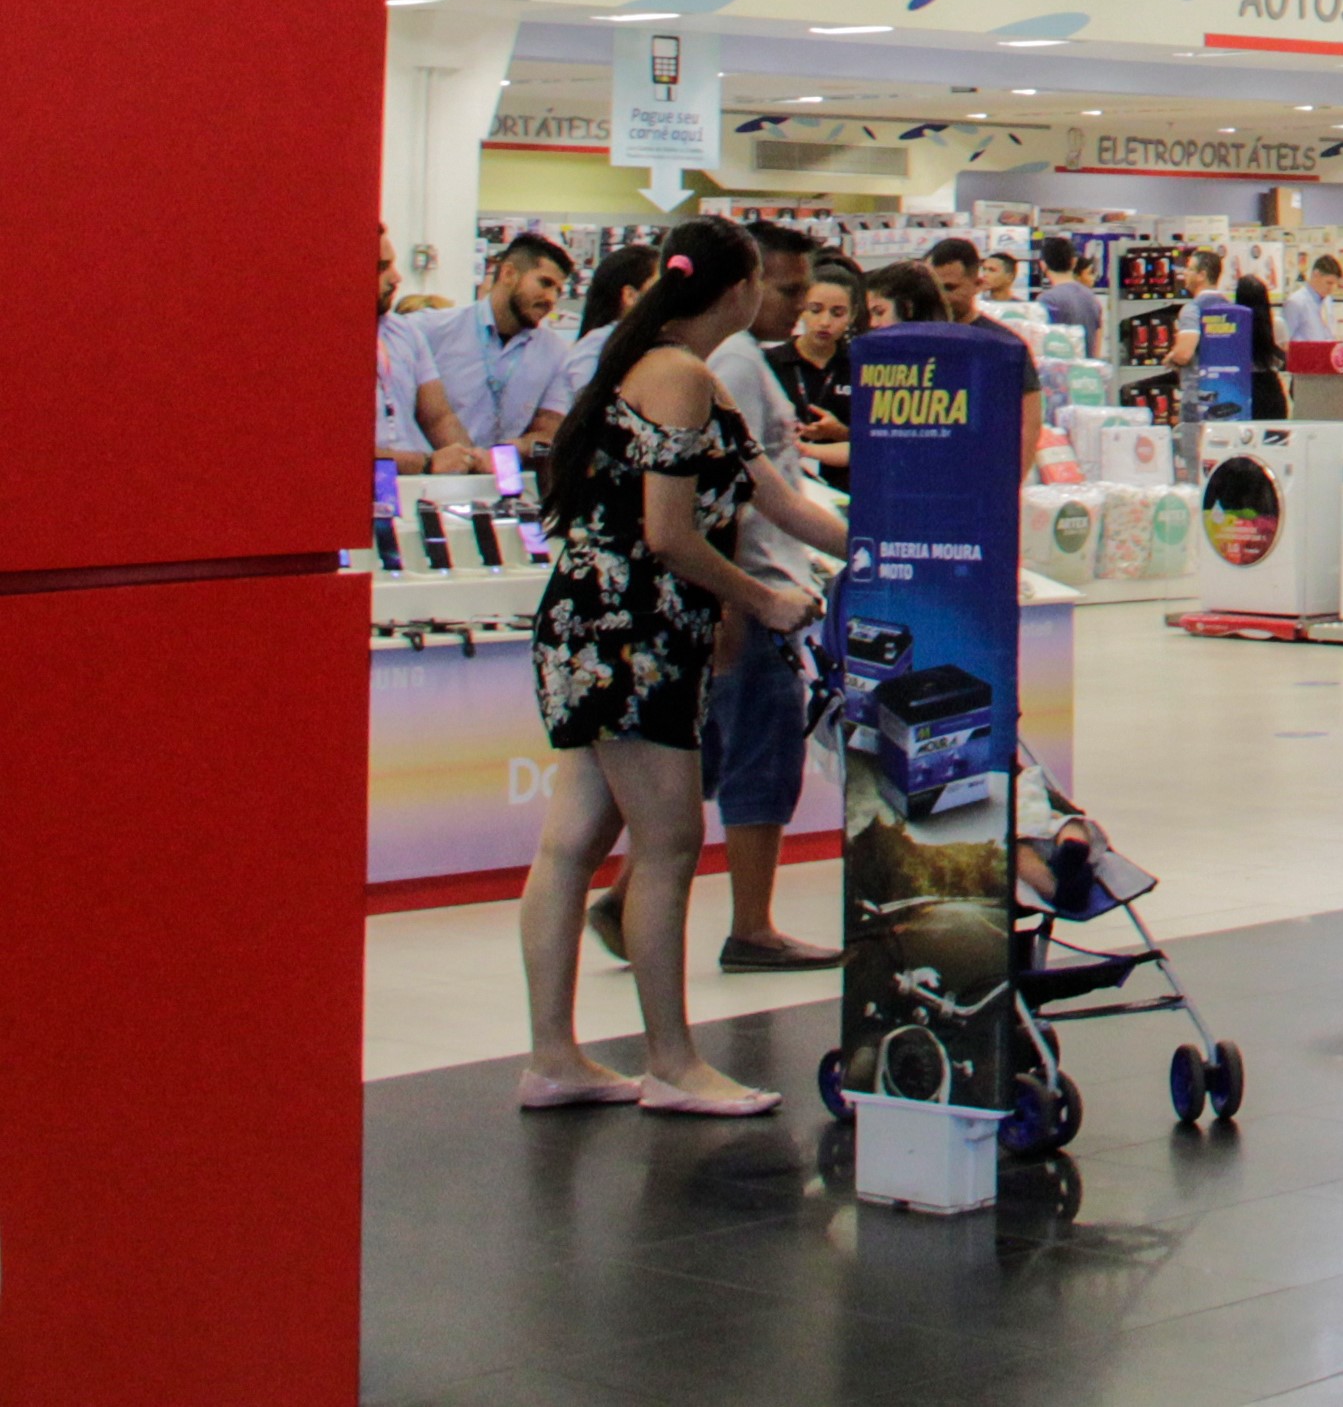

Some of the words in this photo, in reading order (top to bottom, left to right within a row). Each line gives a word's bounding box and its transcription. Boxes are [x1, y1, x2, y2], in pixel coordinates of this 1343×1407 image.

[631, 108, 674, 125] Pague
[676, 111, 699, 124] seu
[672, 128, 704, 142] aqui
[1097, 135, 1317, 172] ELETROPORTÁTEIS
[860, 364, 918, 387] MOURA
[922, 357, 936, 387] É
[869, 389, 967, 425] MOURA
[880, 542, 929, 558] BATERIA
[931, 543, 983, 560] MOURA
[878, 564, 914, 579] MOTO
